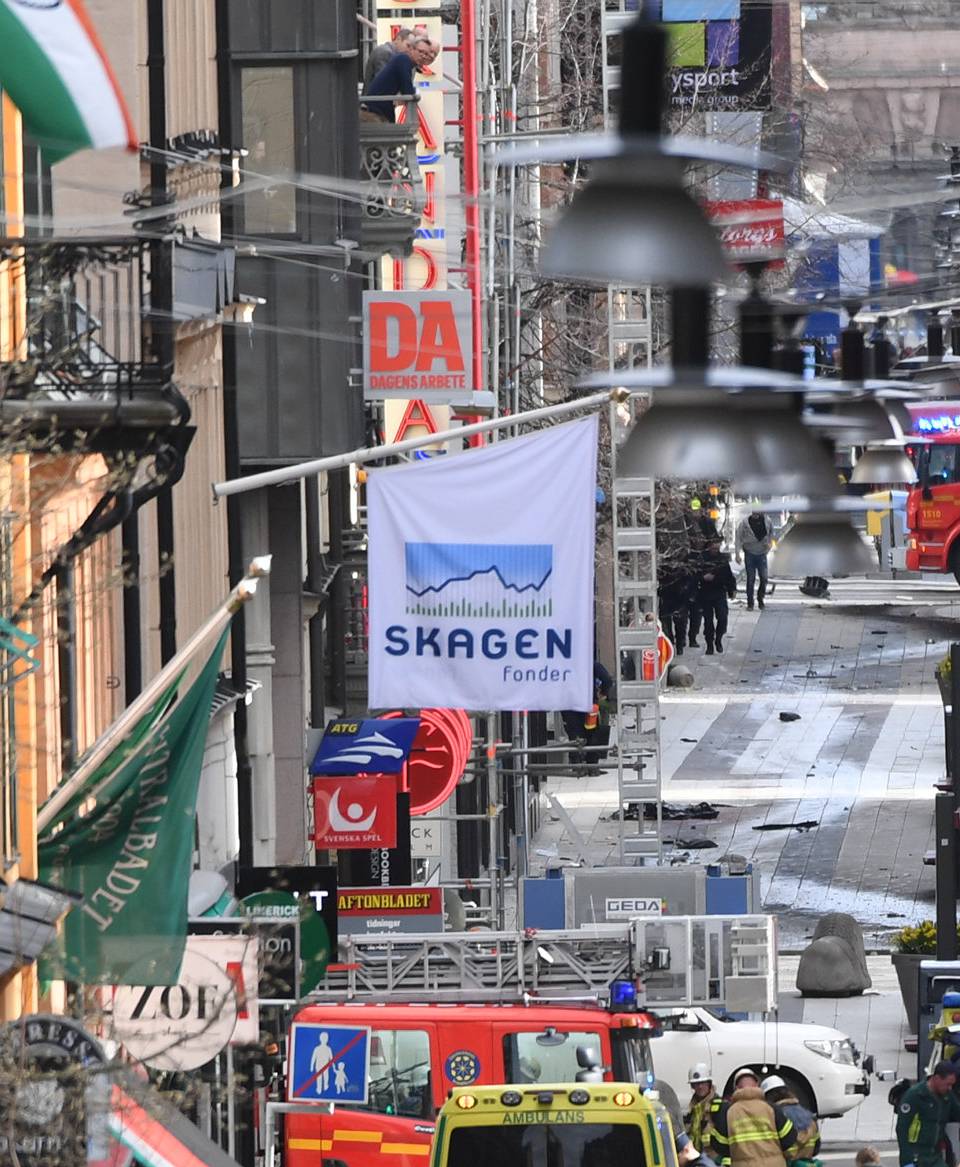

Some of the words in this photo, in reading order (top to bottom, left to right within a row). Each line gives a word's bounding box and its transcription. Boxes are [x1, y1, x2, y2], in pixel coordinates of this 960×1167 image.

[369, 301, 465, 372] DA
[370, 374, 418, 390] DAGENS
[419, 373, 466, 389] ARBETE
[384, 625, 573, 660] SKAGEN
[503, 665, 572, 682] fonder
[330, 723, 359, 733] ATG
[338, 893, 431, 910] AFTONBLADET
[607, 900, 660, 911] GEDA
[366, 919, 401, 929] tidningar
[502, 1112, 586, 1124] AMBULANS
